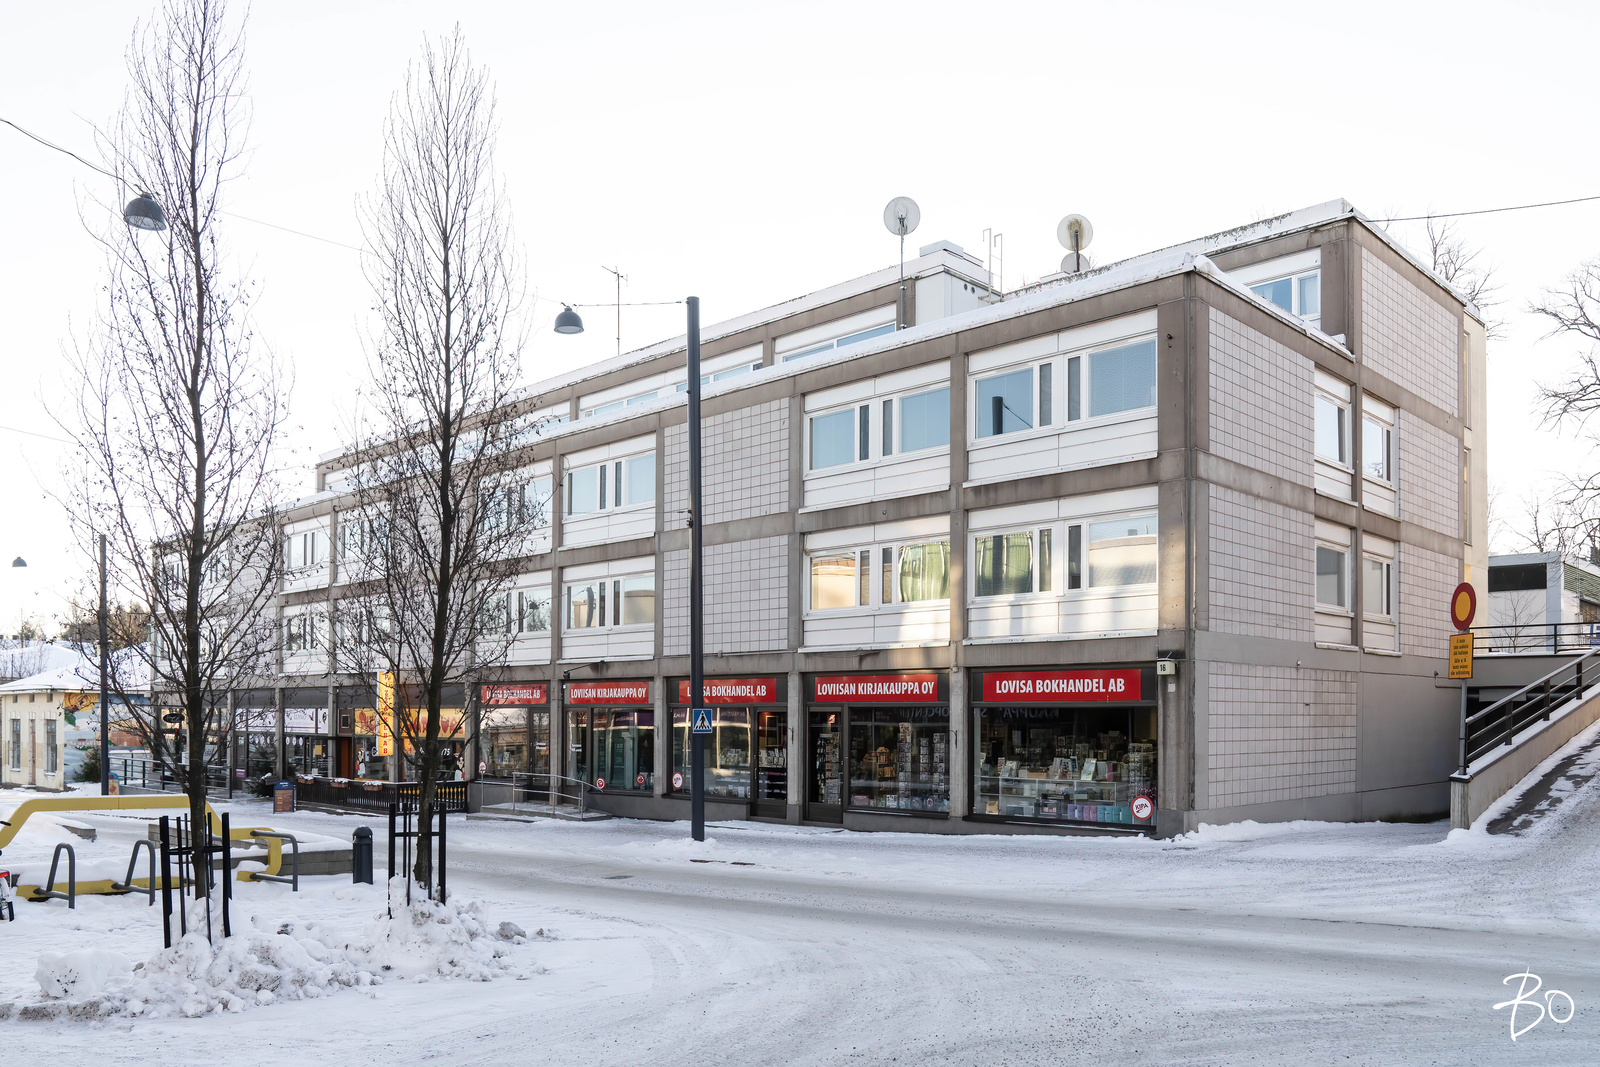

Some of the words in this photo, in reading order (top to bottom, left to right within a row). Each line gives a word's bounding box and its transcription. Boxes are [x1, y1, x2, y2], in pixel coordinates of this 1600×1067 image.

[1159, 663, 1166, 672] 16
[687, 685, 711, 697] LSA
[711, 685, 755, 697] BOKHANDEL
[756, 685, 767, 696] AB
[817, 683, 856, 696] LOVIISAN
[857, 682, 920, 695] KIRJAKAUPPA
[921, 681, 935, 695] OY
[995, 680, 1034, 694] LOVISA
[1035, 679, 1106, 693] BOKHANDEL
[1107, 678, 1126, 693] AB
[570, 688, 596, 699] LOVIISAN
[597, 687, 637, 699] KIRJAKAUPPA
[638, 687, 647, 698] OY
